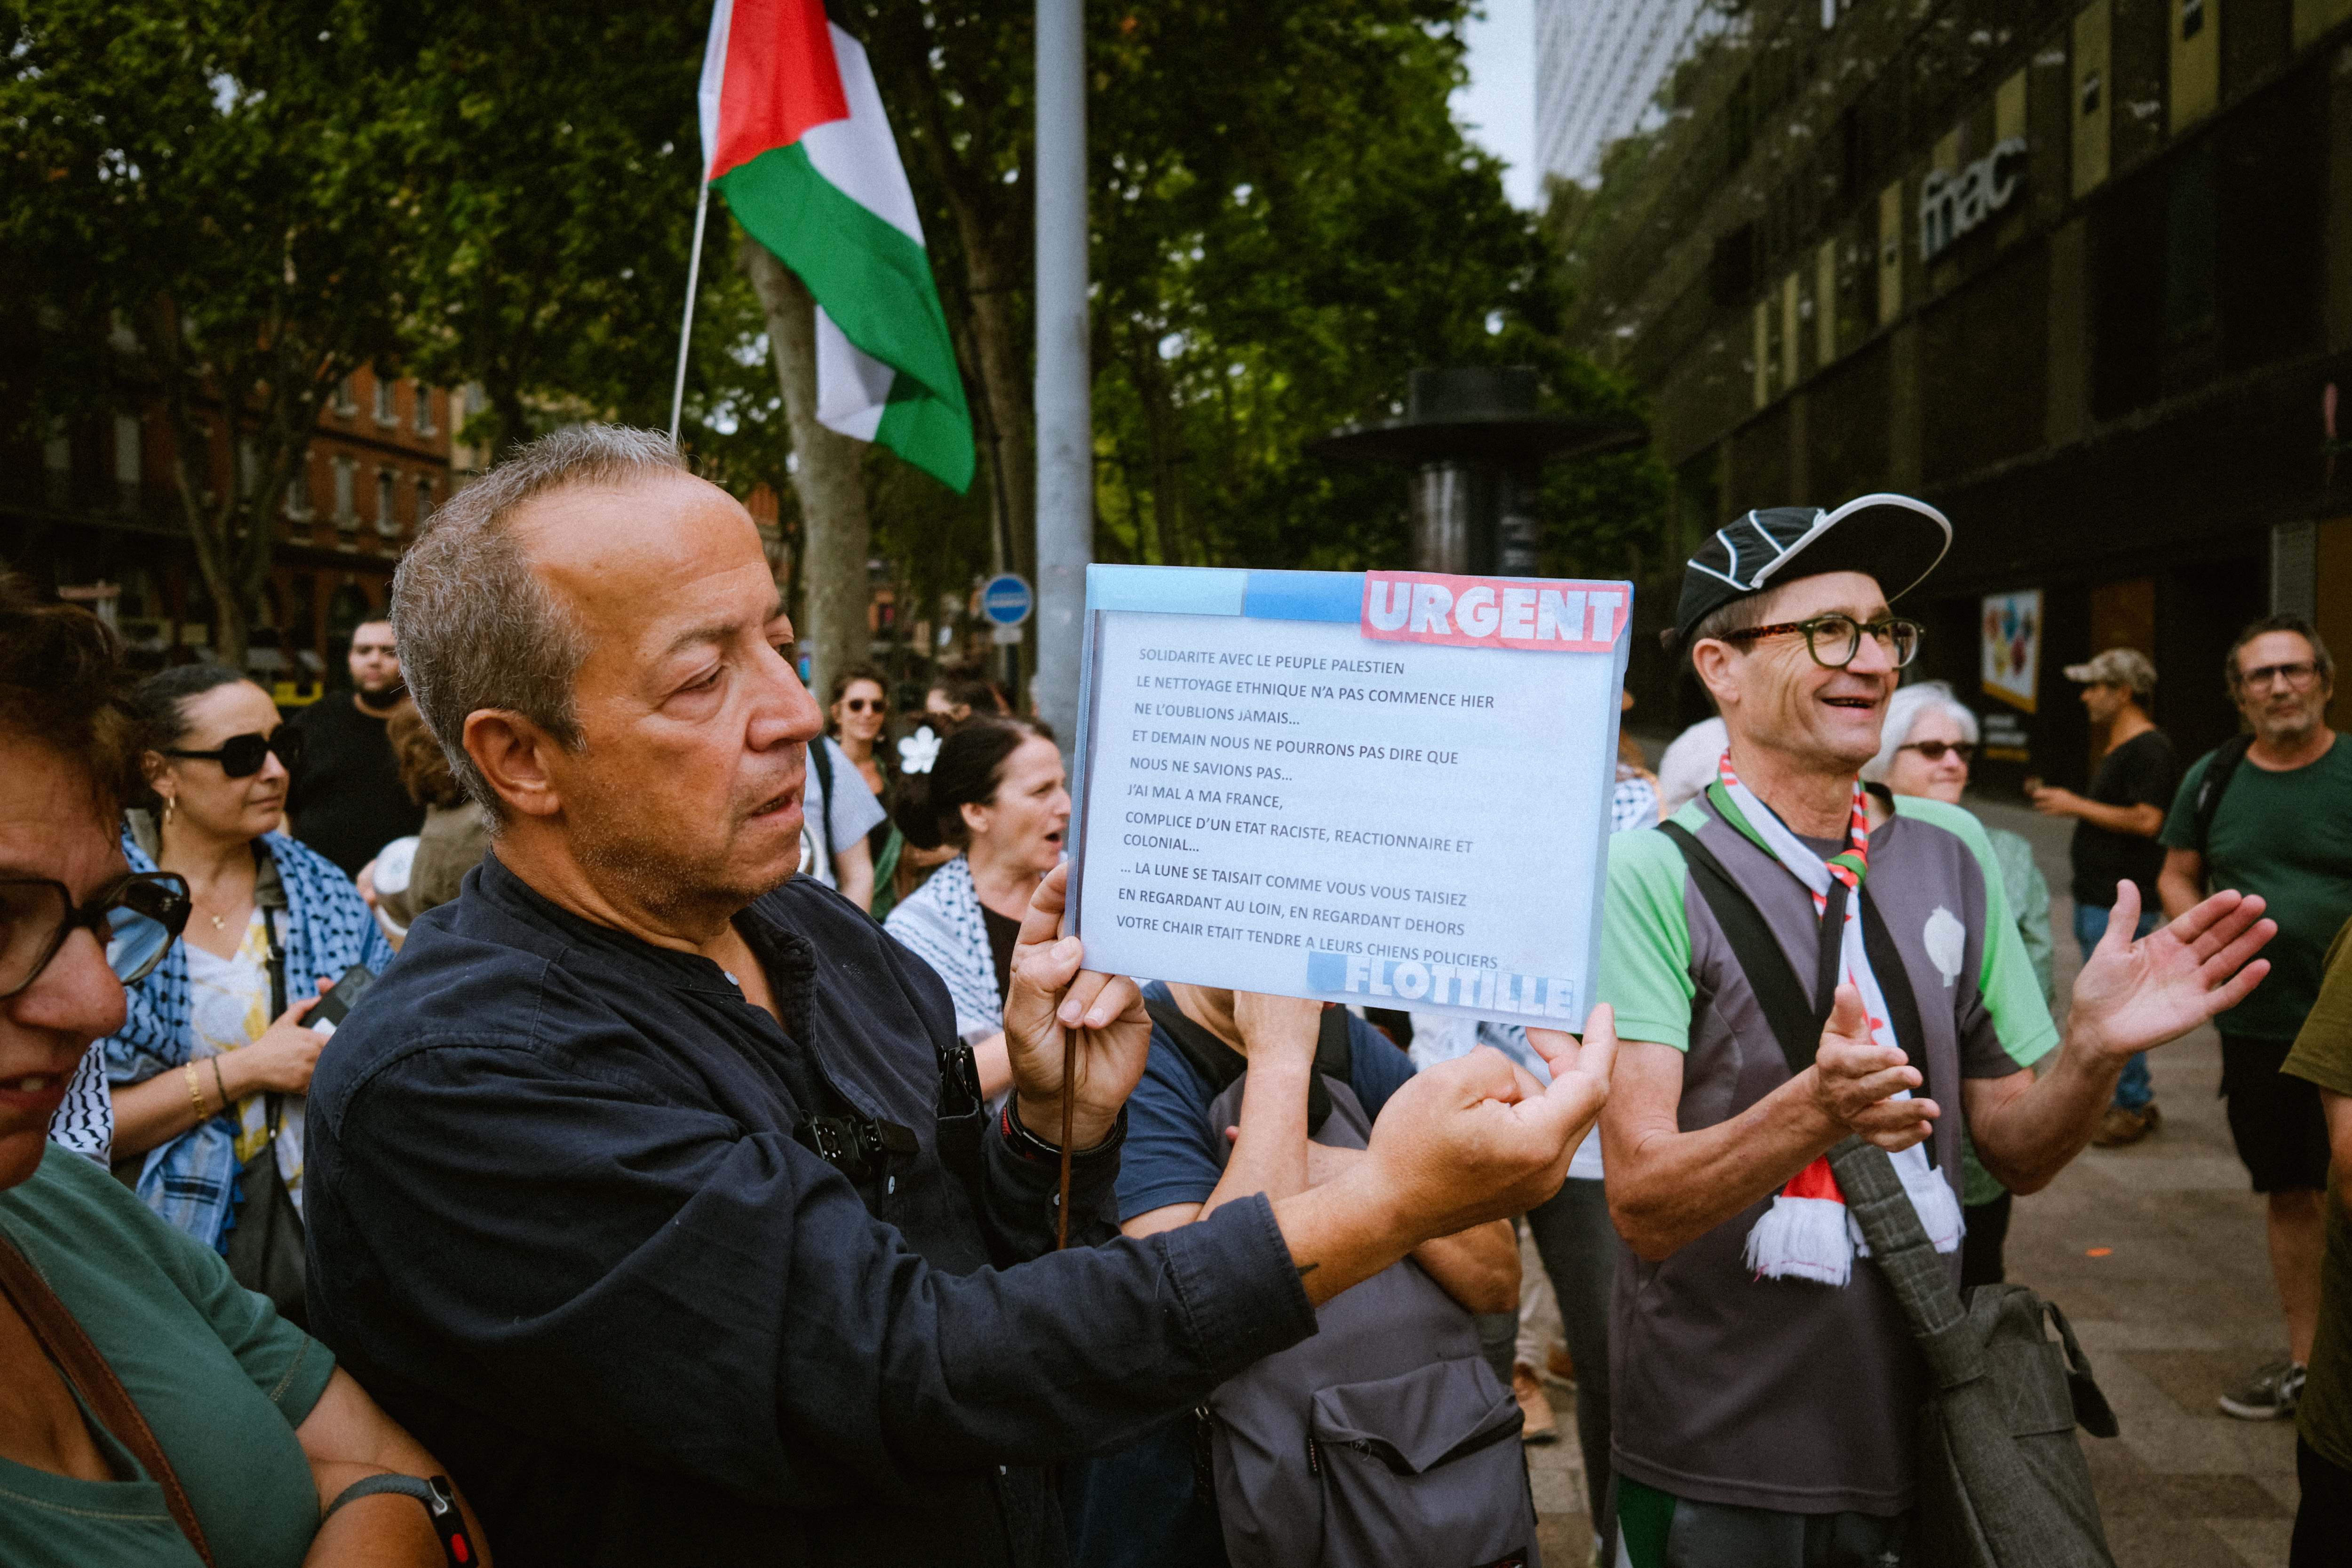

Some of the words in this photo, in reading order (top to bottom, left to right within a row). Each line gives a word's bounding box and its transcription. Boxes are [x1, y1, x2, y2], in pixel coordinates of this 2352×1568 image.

[1920, 138, 2026, 261] fnac
[1367, 580, 1623, 644] URGENT
[1139, 648, 1215, 664] SOLIDARITE
[1218, 652, 1253, 667] AVEC
[1256, 654, 1271, 668] LE
[1275, 655, 1327, 671] PEUPLE
[1330, 659, 1405, 675] PALESTIEN
[1134, 702, 1152, 716] NE
[1156, 704, 1235, 721] L'OUBLIONS
[1136, 675, 1150, 688] LE
[1154, 676, 1232, 693] NETTOYAGE
[1236, 680, 1307, 698] ETHNIQUE
[1311, 685, 1335, 700] N'A
[1338, 686, 1365, 701] PAS
[1367, 688, 1456, 707] COMMENCE
[1460, 694, 1495, 709] HIER
[1129, 756, 1168, 772] NOUS
[1172, 760, 1190, 773] NE
[1193, 761, 1253, 779] SAVIONS
[1132, 729, 1148, 742] ET
[1151, 731, 1207, 747] DEMAIN
[1210, 735, 1250, 750] NOUS
[1253, 738, 1272, 752] NE
[1275, 739, 1355, 758] POURRONS
[1358, 745, 1386, 760] PAS
[1389, 747, 1423, 763] DIRE
[1426, 749, 1459, 765] QUE
[1127, 784, 1149, 797] J'AI
[1152, 785, 1181, 800] MAL
[1184, 788, 1195, 801] A
[1198, 789, 1222, 804] MA
[1225, 791, 1283, 811] FRANCE,
[1125, 811, 1192, 829] COMPLICE
[1195, 817, 1232, 833] D'UN
[1234, 820, 1267, 835] ETAT
[1270, 823, 1330, 843] RACISTE,
[1334, 829, 1451, 852] REACTIONNAIRE
[1455, 839, 1473, 853] ET
[1135, 862, 1151, 876] LA
[1154, 863, 1189, 879] LUNE
[1192, 867, 1208, 881] SE
[1210, 868, 1263, 886] TAISAIT
[1264, 874, 1322, 892] COMME
[1326, 881, 1367, 897] VOUS
[1370, 885, 1411, 901] VOUS
[1414, 889, 1468, 907] TAISIEZ
[1118, 887, 1136, 901] EN
[1139, 889, 1222, 910] REGARDANT
[1224, 899, 1245, 913] AU
[1248, 901, 1285, 919] LOIN,
[1289, 905, 1309, 920] EN
[1312, 907, 1401, 929] REGARDANT
[1405, 917, 1465, 936] DEHORS
[1116, 915, 1159, 931] VOTRE
[1162, 919, 1204, 937] CHAIR
[1206, 924, 1244, 940] ETAIT
[1247, 929, 1302, 948] TENDRE
[1304, 935, 1317, 950] A
[1319, 937, 1364, 955] LEURS
[1366, 942, 1420, 962] CHIENS
[1422, 948, 1499, 970] POLICIERS
[1345, 956, 1573, 1019] FLOTTILLE
